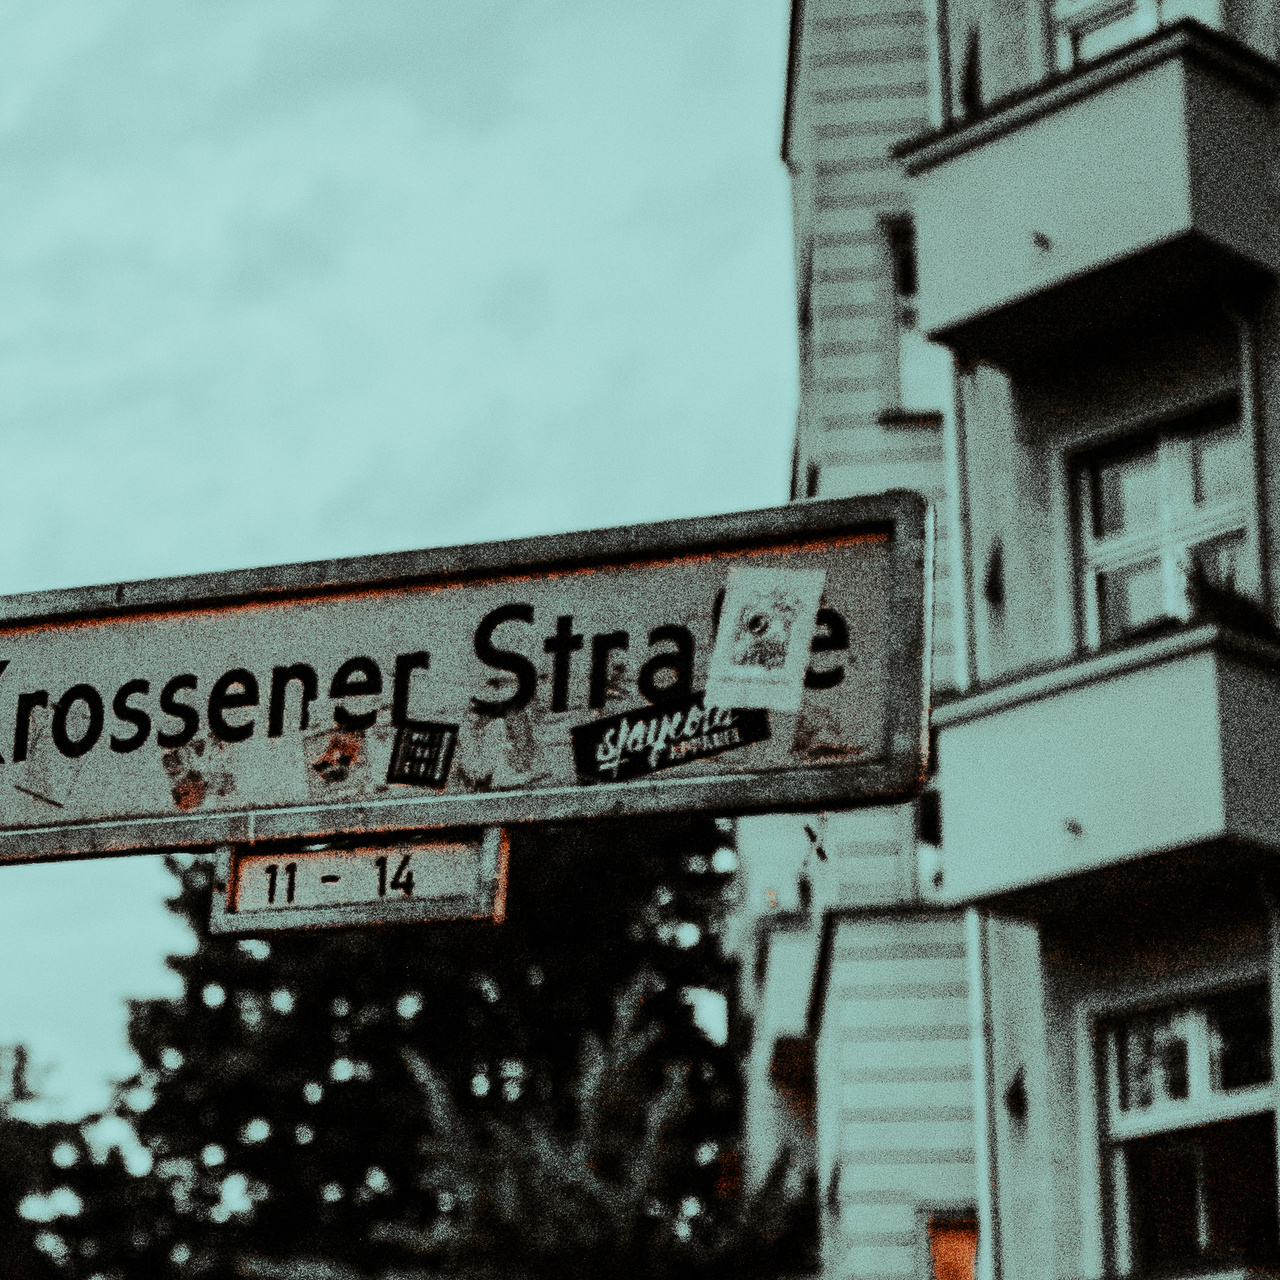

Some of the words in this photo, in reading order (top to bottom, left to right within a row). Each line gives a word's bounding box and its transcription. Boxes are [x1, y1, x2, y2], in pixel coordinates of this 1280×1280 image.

[471, 584, 850, 718] Strae
[265, 862, 297, 904] 11
[375, 854, 415, 896] 14
